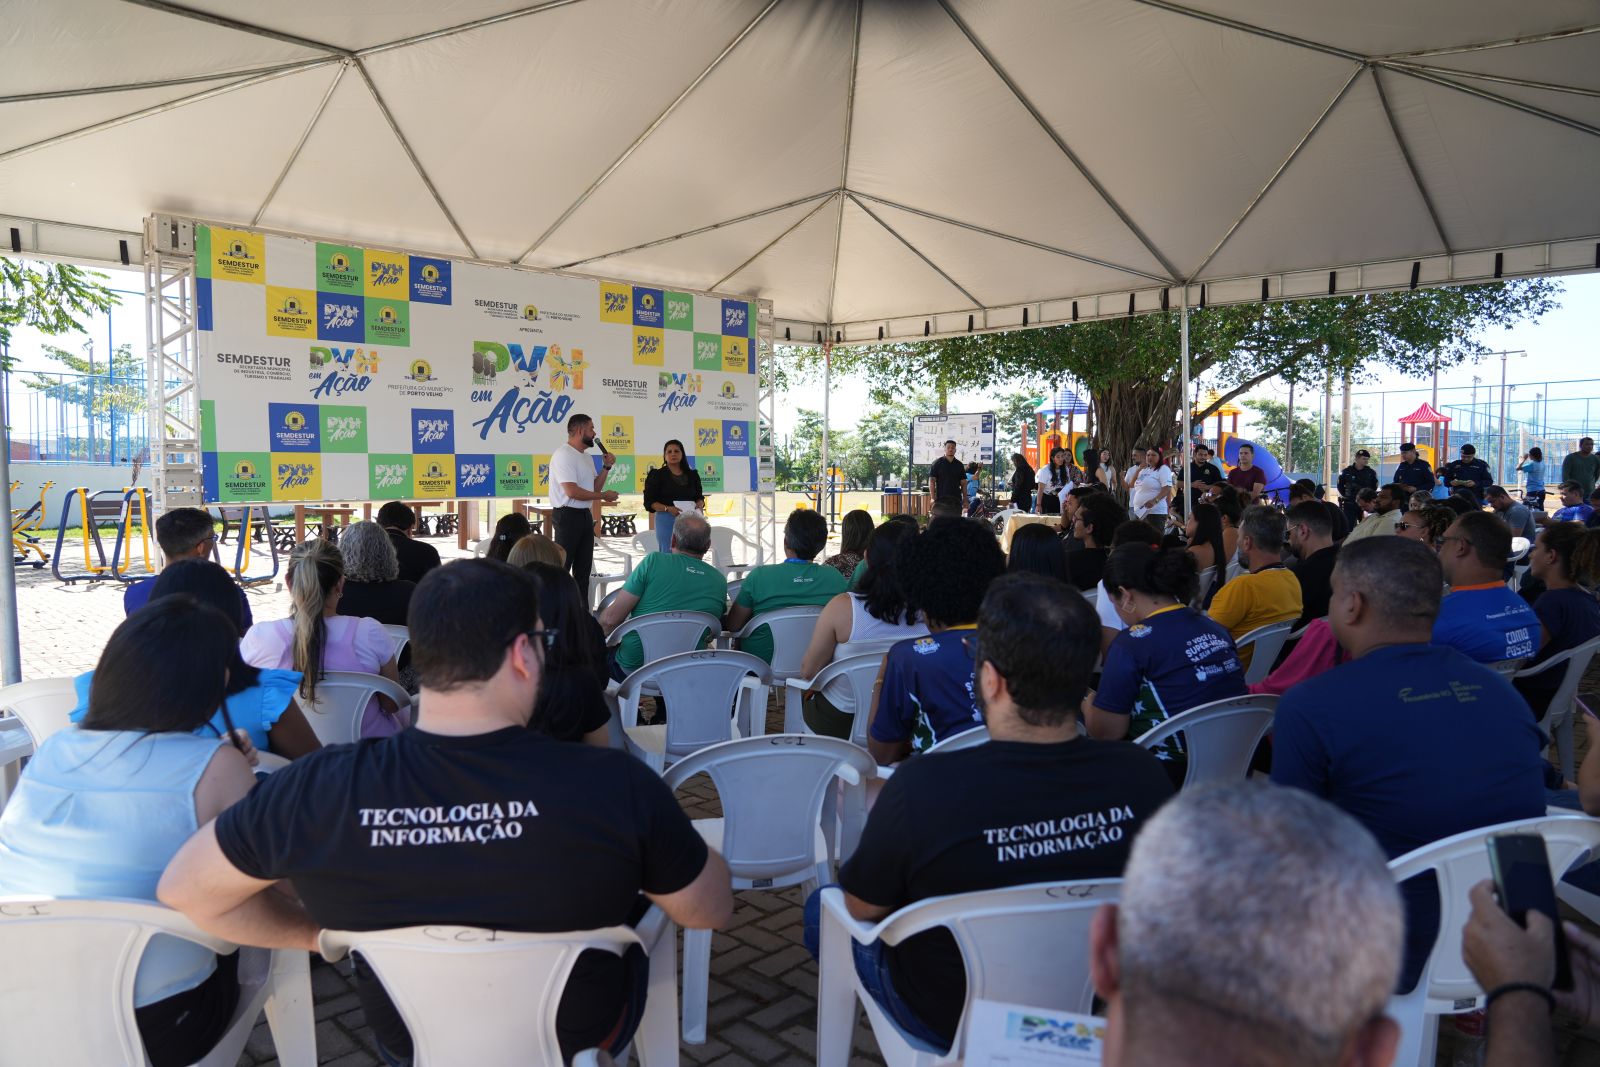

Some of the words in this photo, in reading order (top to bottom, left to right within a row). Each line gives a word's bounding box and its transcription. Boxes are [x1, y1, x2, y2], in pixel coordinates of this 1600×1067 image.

[217, 258, 260, 270] SEMDESTUR
[322, 271, 359, 282] SEMDESTUR
[413, 283, 448, 292] SEMDESTUR
[474, 300, 518, 310] SEMDESTUR
[273, 315, 312, 325] SEMDESTUR
[326, 315, 354, 329] Ação
[370, 324, 406, 334] SEMDESTUR
[217, 353, 291, 367] SEMDESTUR
[309, 370, 373, 400] Ação
[602, 378, 648, 389] SEMDESTUR
[470, 390, 493, 402] em
[658, 390, 698, 414] Ação
[472, 386, 575, 441] Ação
[276, 432, 315, 440] SEMDESTUR
[278, 475, 310, 491] Ação
[358, 802, 504, 826] TECNOLOGIA
[508, 800, 540, 818] DA
[983, 811, 1108, 844] TECNOLOGIA
[1109, 804, 1135, 824] DA
[370, 819, 523, 847] INFORMAÇÃO
[997, 826, 1124, 862] INFORMAÇÃO
